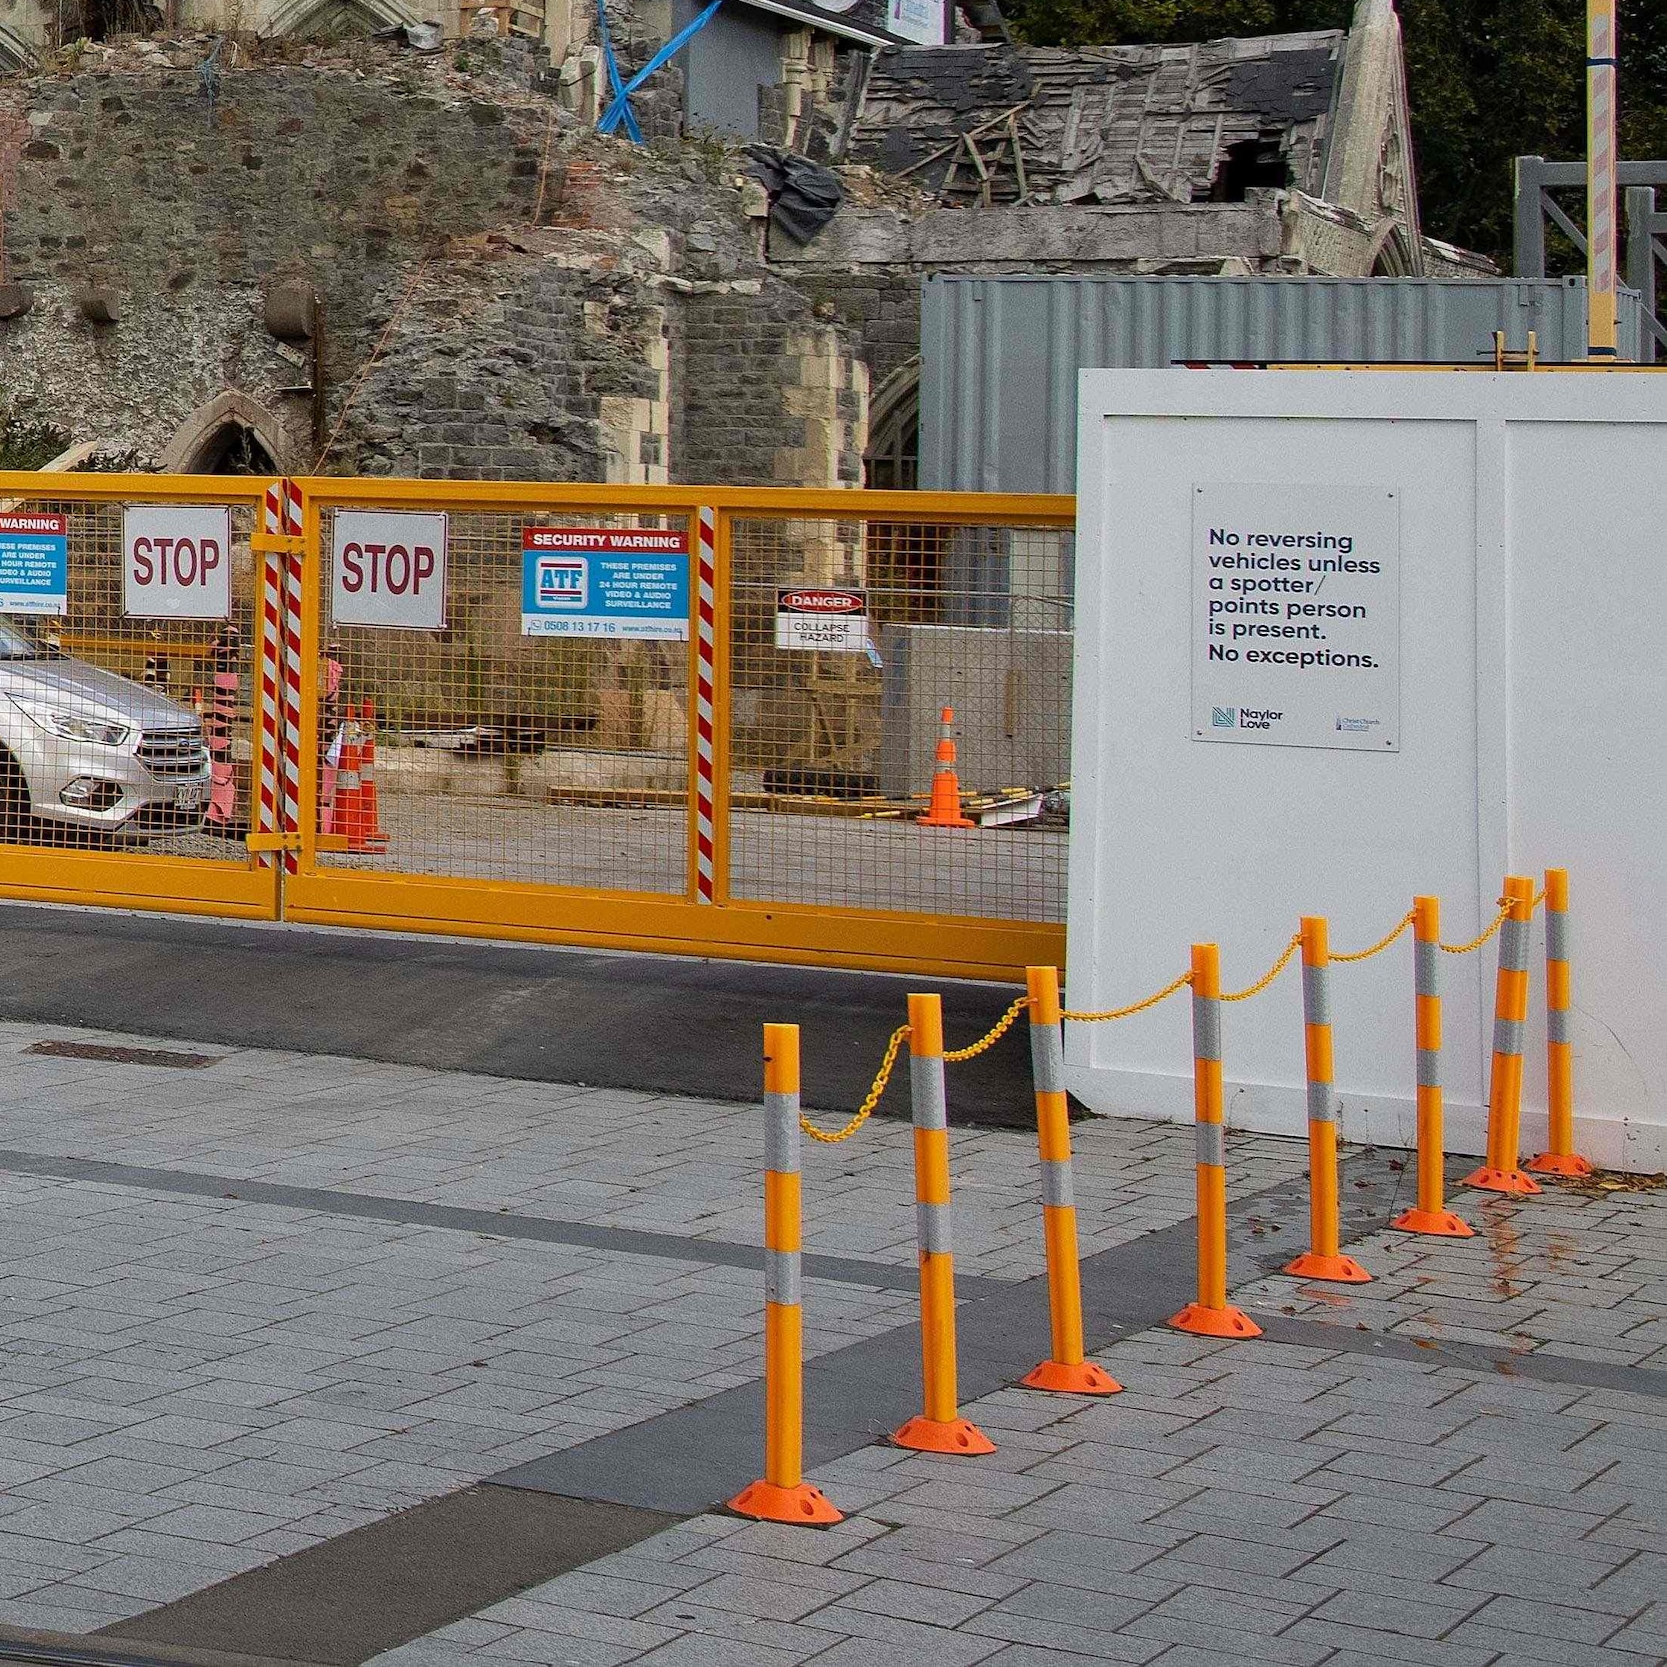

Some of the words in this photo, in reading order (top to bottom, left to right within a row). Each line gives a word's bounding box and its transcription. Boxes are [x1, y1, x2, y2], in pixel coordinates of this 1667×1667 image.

[0, 518, 60, 530] WARNING
[533, 534, 605, 546] SECURITY
[611, 536, 680, 548] WARNING
[1209, 528, 1240, 546] No
[1246, 531, 1353, 554] reversing
[17, 543, 57, 552] PREMISES
[1, 551, 17, 559] ARE
[18, 552, 46, 560] UNDER
[1, 560, 23, 568] HOUR
[24, 561, 57, 569] REMOTE
[133, 537, 220, 587] STOP
[600, 562, 629, 570] THESE
[631, 563, 677, 571] PREMISES
[1209, 552, 1301, 570] vehicles
[1308, 555, 1381, 574] unless
[27, 569, 52, 577] AUDIO
[341, 542, 434, 595] STOP
[541, 569, 583, 589] ATF
[632, 572, 664, 580] UNDER
[599, 581, 611, 589] 24
[612, 582, 638, 590] HOUR
[640, 582, 678, 590] REMOTE
[1208, 576, 1223, 590] a
[1230, 575, 1326, 595] spotter/
[605, 600, 672, 609] SURVEILLANCE
[791, 595, 853, 607] DANGER
[1209, 596, 1280, 617] points
[1287, 602, 1366, 619] person
[544, 620, 568, 631] 0508
[572, 622, 584, 632] 13
[587, 622, 599, 632] 17
[603, 622, 615, 632] 16
[794, 622, 850, 633] COLLAPSE
[1209, 618, 1225, 635] is
[1233, 623, 1326, 640] present.
[799, 633, 844, 642] HAZARD
[1209, 644, 1239, 662] No
[1246, 649, 1379, 669] exceptions.
[1240, 708, 1283, 723] Naylor
[1240, 718, 1270, 730] Love
